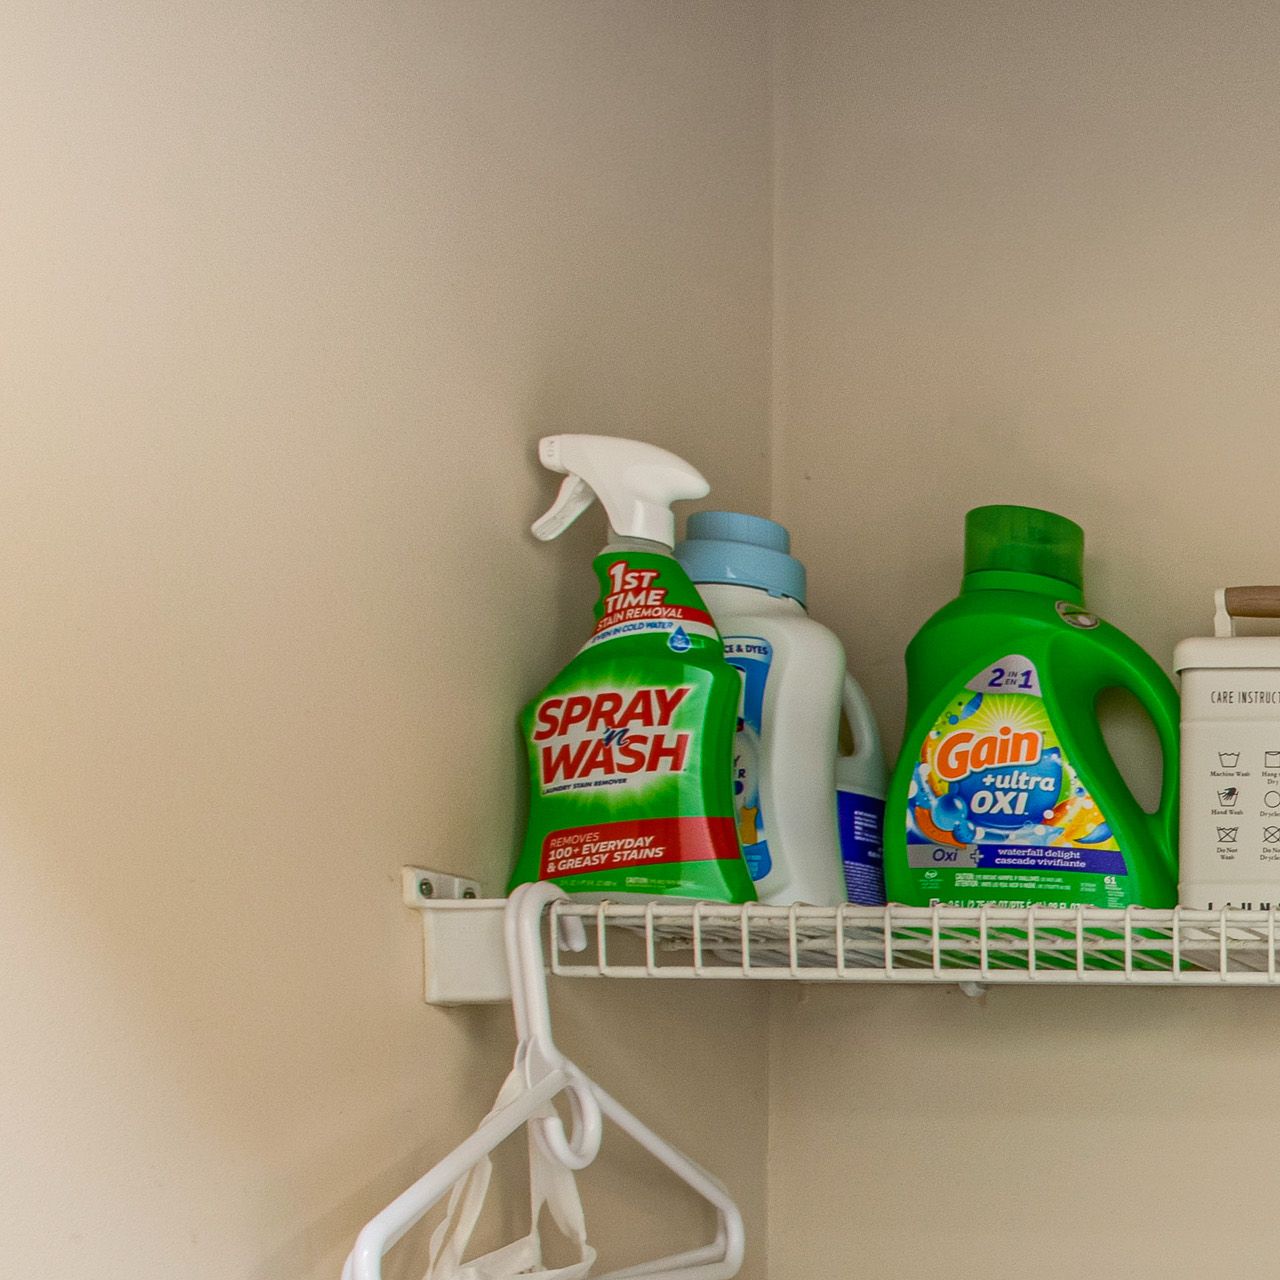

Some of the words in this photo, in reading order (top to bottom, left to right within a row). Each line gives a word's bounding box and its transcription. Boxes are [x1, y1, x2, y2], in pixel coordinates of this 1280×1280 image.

[610, 562, 658, 593] 1ST
[605, 589, 666, 613] TIME
[597, 608, 626, 630] STAIN
[626, 607, 684, 619] REMOVAL
[621, 622, 645, 633] COLD
[645, 621, 674, 629] WATER
[745, 644, 768, 655] DYES
[988, 668, 1005, 688] 2
[1018, 669, 1033, 689] 1
[1210, 690, 1234, 704] CARE
[533, 688, 691, 741] SPRAY
[542, 734, 689, 785] WASH
[937, 726, 1040, 780] Gain
[542, 784, 571, 795] LAUNDRY
[573, 781, 593, 790] STAIN
[594, 777, 628, 787] REMOVER
[971, 790, 1028, 816] OXI
[548, 847, 580, 861] 100+
[581, 836, 655, 856] EVERYDAY
[550, 832, 600, 849] REMOVES
[547, 862, 556, 873] &
[557, 855, 609, 871] GREASY
[612, 847, 665, 863] STAINS
[932, 849, 957, 862] Oxi
[994, 857, 1036, 866] cascade
[1037, 858, 1087, 868] vivifiante
[997, 848, 1044, 857] waterfall
[1044, 849, 1081, 860] delight
[1104, 876, 1117, 885] 61
